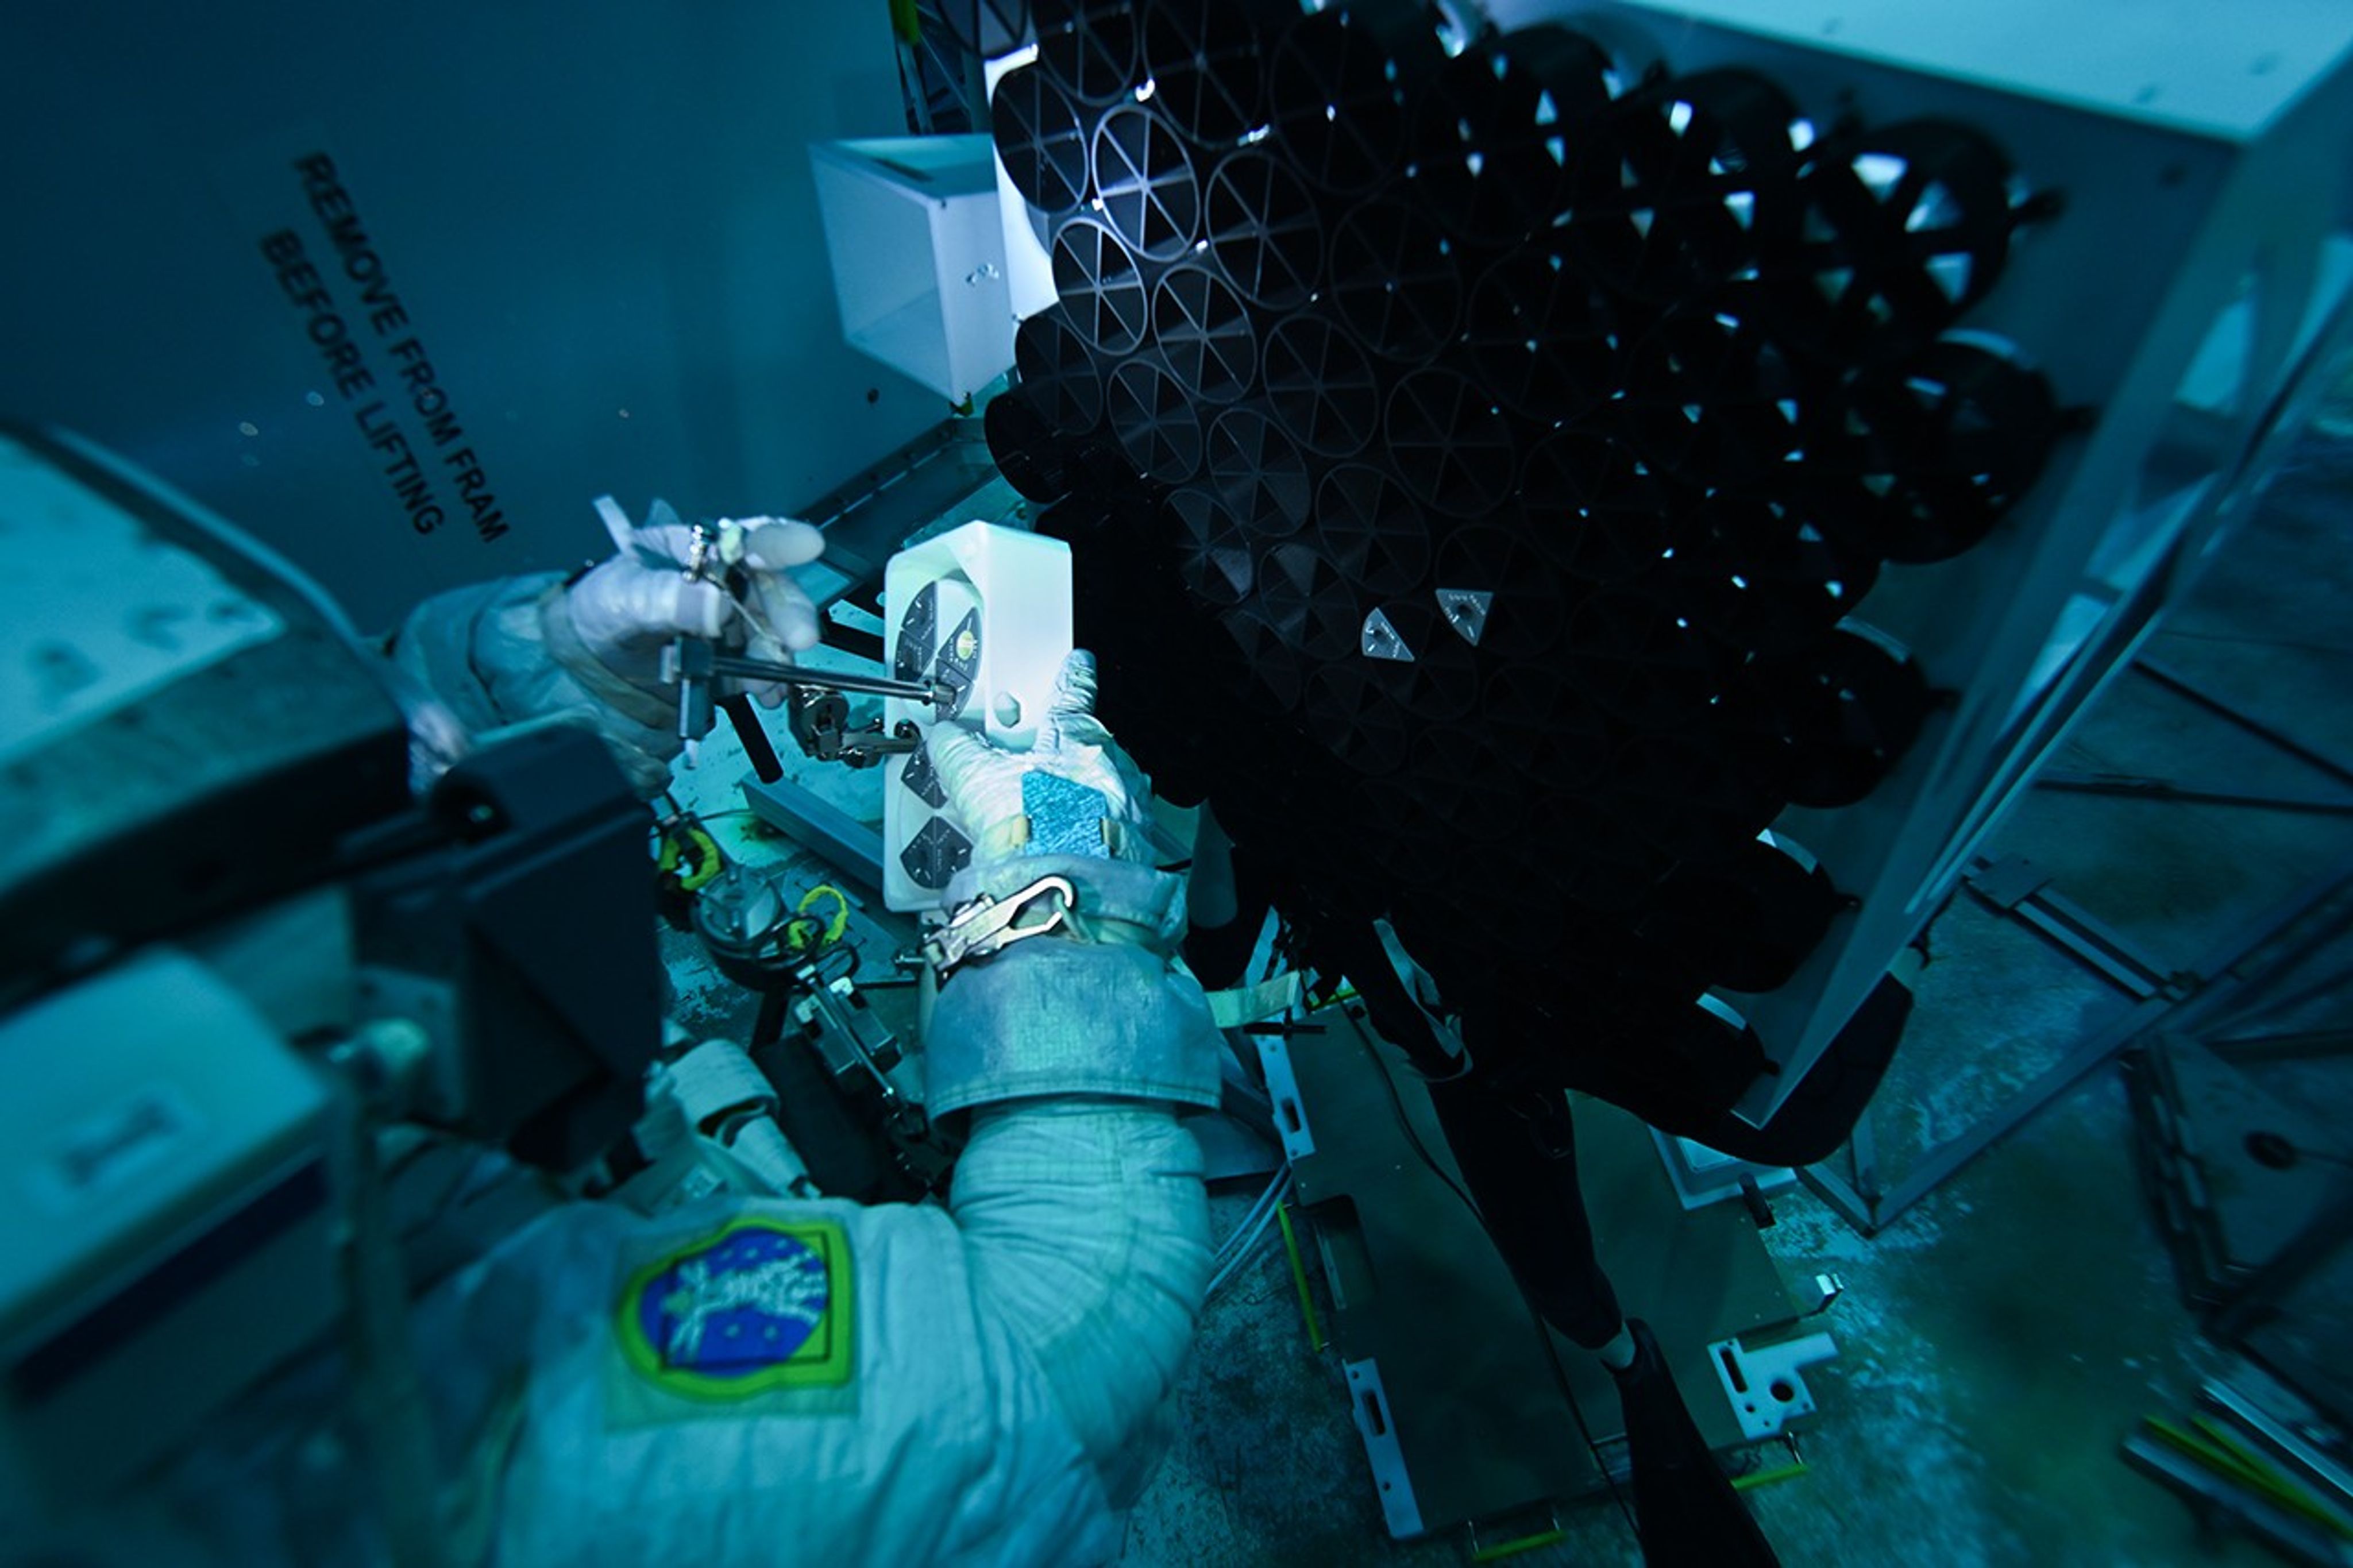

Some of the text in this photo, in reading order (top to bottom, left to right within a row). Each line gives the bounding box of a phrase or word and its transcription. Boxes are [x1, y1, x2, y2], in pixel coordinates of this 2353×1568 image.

[260, 229, 446, 535] BEFORE LIFTING
[296, 152, 509, 544] REMOVE FROM FRAM
